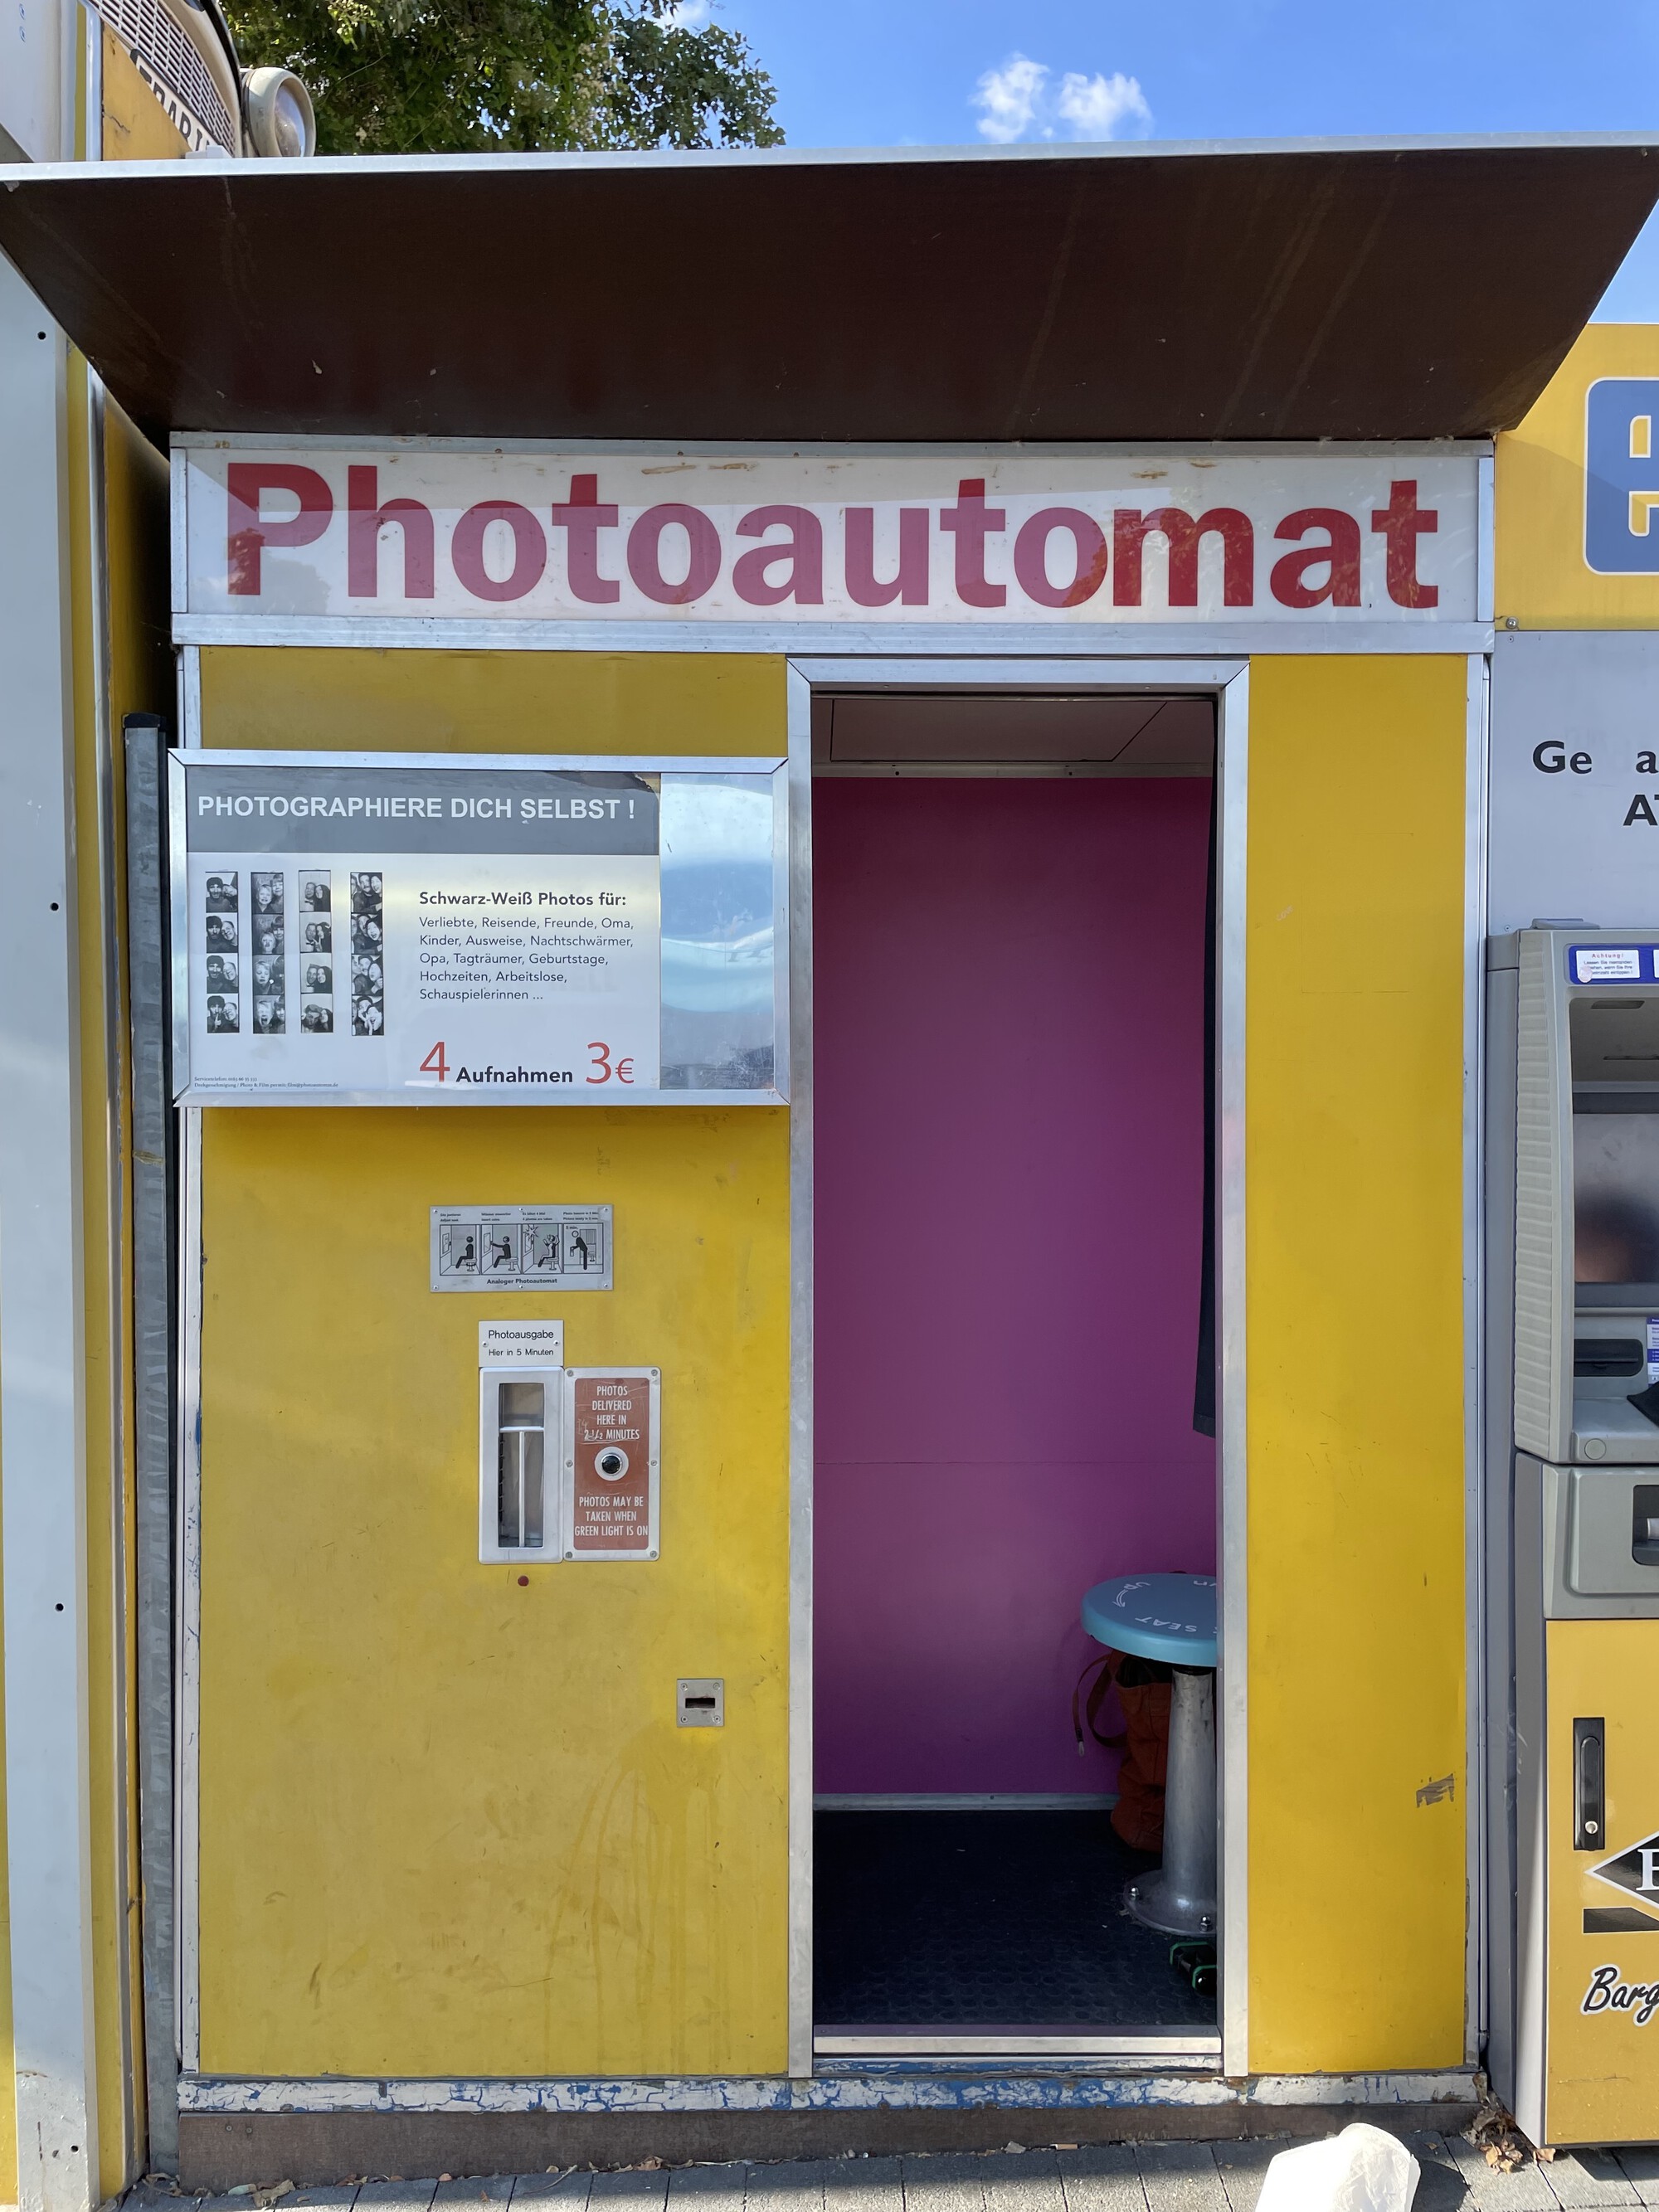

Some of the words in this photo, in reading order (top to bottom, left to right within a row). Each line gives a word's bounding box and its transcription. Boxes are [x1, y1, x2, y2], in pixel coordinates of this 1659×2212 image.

[227, 463, 1438, 609] Photoautomat
[198, 796, 442, 818] PHOTOGRAPHIERE
[451, 798, 512, 819] DICH
[520, 799, 620, 819] SELBST
[1623, 794, 1659, 826] A
[419, 892, 533, 906] Schwarz-Weiß
[538, 892, 594, 906] Photos
[599, 892, 627, 906] für:
[419, 916, 478, 929] Verliebte,
[482, 917, 540, 929] Reisende,
[544, 917, 597, 930] Freunde,
[601, 917, 635, 930] Oma,
[420, 935, 462, 947] Kinder,
[465, 935, 526, 947] Ausweise,
[530, 936, 634, 947] Nachtschwärmer,
[420, 953, 450, 966] Opa,
[454, 953, 525, 966] Tagträumer,
[528, 953, 609, 966] Geburtstage,
[420, 971, 492, 984] Hochzeiten,
[495, 971, 567, 984] Arbeitslose,
[420, 989, 528, 1003] Schauspielerinnen
[419, 1041, 450, 1083] 4
[456, 1066, 573, 1083] Aufnahmen
[488, 1330, 554, 1340] Photoausgabe
[525, 1348, 554, 1356] Minuten
[596, 1385, 628, 1397] PHOTOS
[591, 1400, 632, 1411] DELIVERED
[596, 1414, 615, 1426] HERE
[618, 1414, 627, 1425] IN
[606, 1429, 640, 1440] MINUTES
[579, 1496, 611, 1507] PHOTOS
[613, 1496, 631, 1507] MAY
[635, 1496, 644, 1507] BE
[586, 1511, 611, 1522] TAKEN
[614, 1511, 637, 1521] WHEN
[574, 1525, 598, 1536] GREEN
[601, 1525, 624, 1536] LIGHT
[626, 1525, 634, 1535] IS
[636, 1525, 649, 1535] ON
[1135, 1616, 1197, 1633] SEAT
